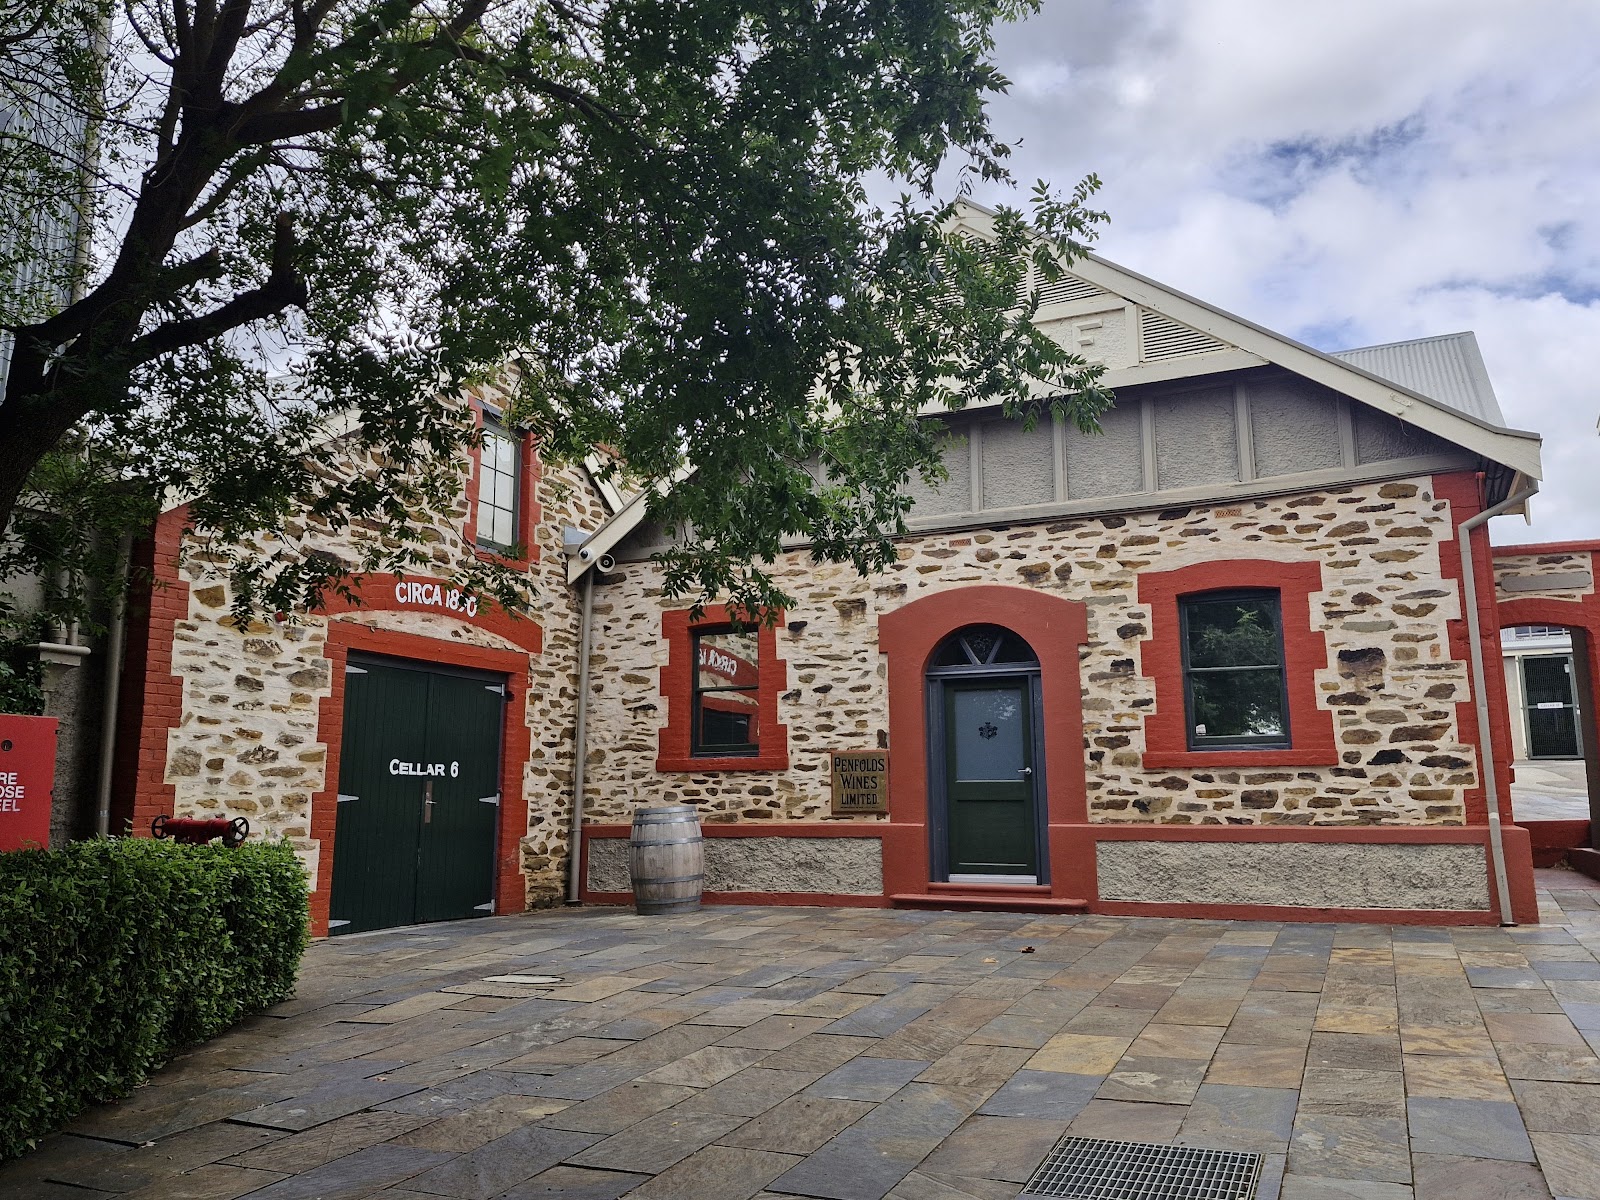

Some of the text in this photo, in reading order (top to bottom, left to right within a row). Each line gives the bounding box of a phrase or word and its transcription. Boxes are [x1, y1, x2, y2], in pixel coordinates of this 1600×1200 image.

[395, 581, 478, 618] CIRCA 180
[389, 758, 459, 778] CELLAR 6
[834, 756, 885, 773] PENFOLDS
[840, 773, 878, 790] WINES
